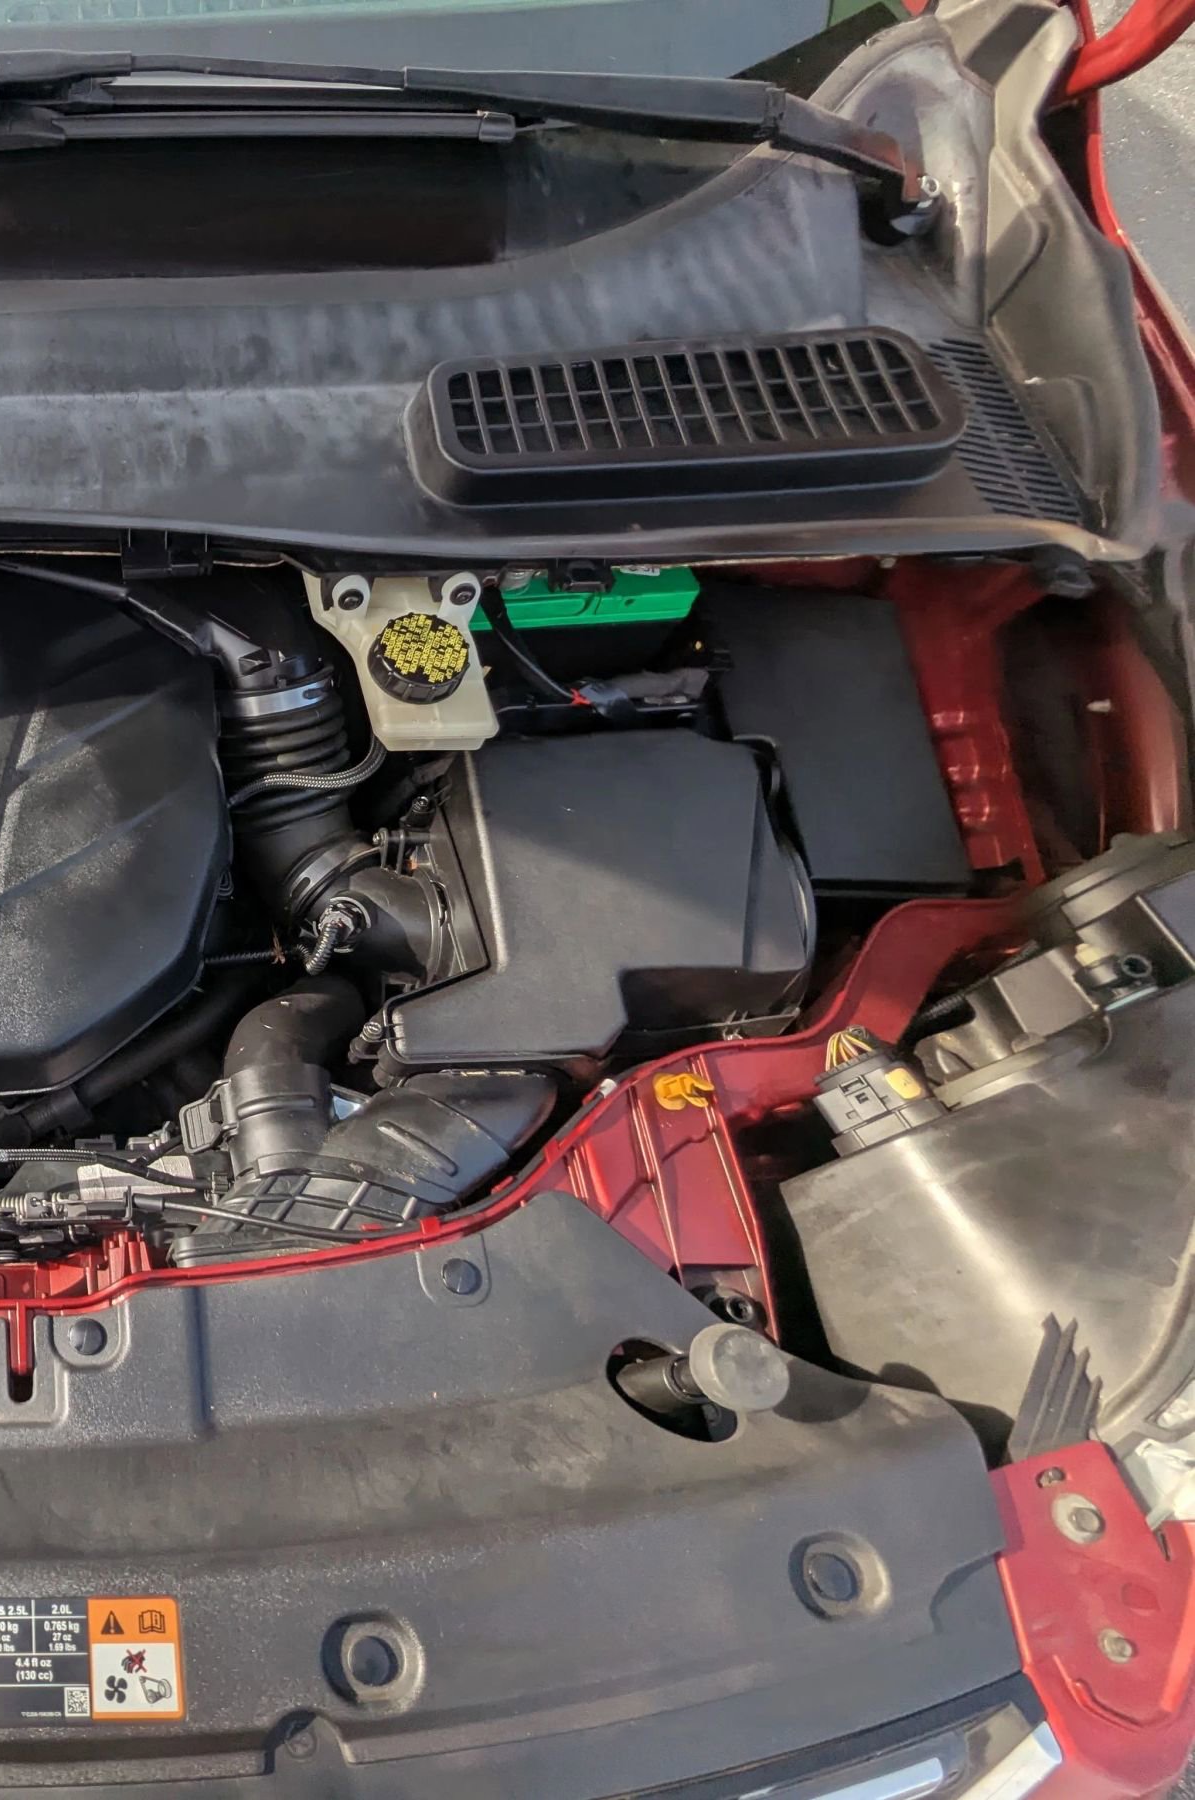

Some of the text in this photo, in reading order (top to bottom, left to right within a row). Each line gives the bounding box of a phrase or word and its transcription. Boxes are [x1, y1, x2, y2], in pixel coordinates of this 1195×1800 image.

[7, 1605, 28, 1616] 2.5L
[51, 1604, 72, 1615] 2.0L
[7, 1621, 19, 1634] kg
[44, 1620, 80, 1633] 0.765 kg
[52, 1633, 61, 1641] 27
[3, 1643, 15, 1652] lbs
[49, 1643, 77, 1652] 1.69 lbs
[15, 1657, 52, 1667] 4.4 fl oz
[15, 1670, 54, 1683] (130 cc)
